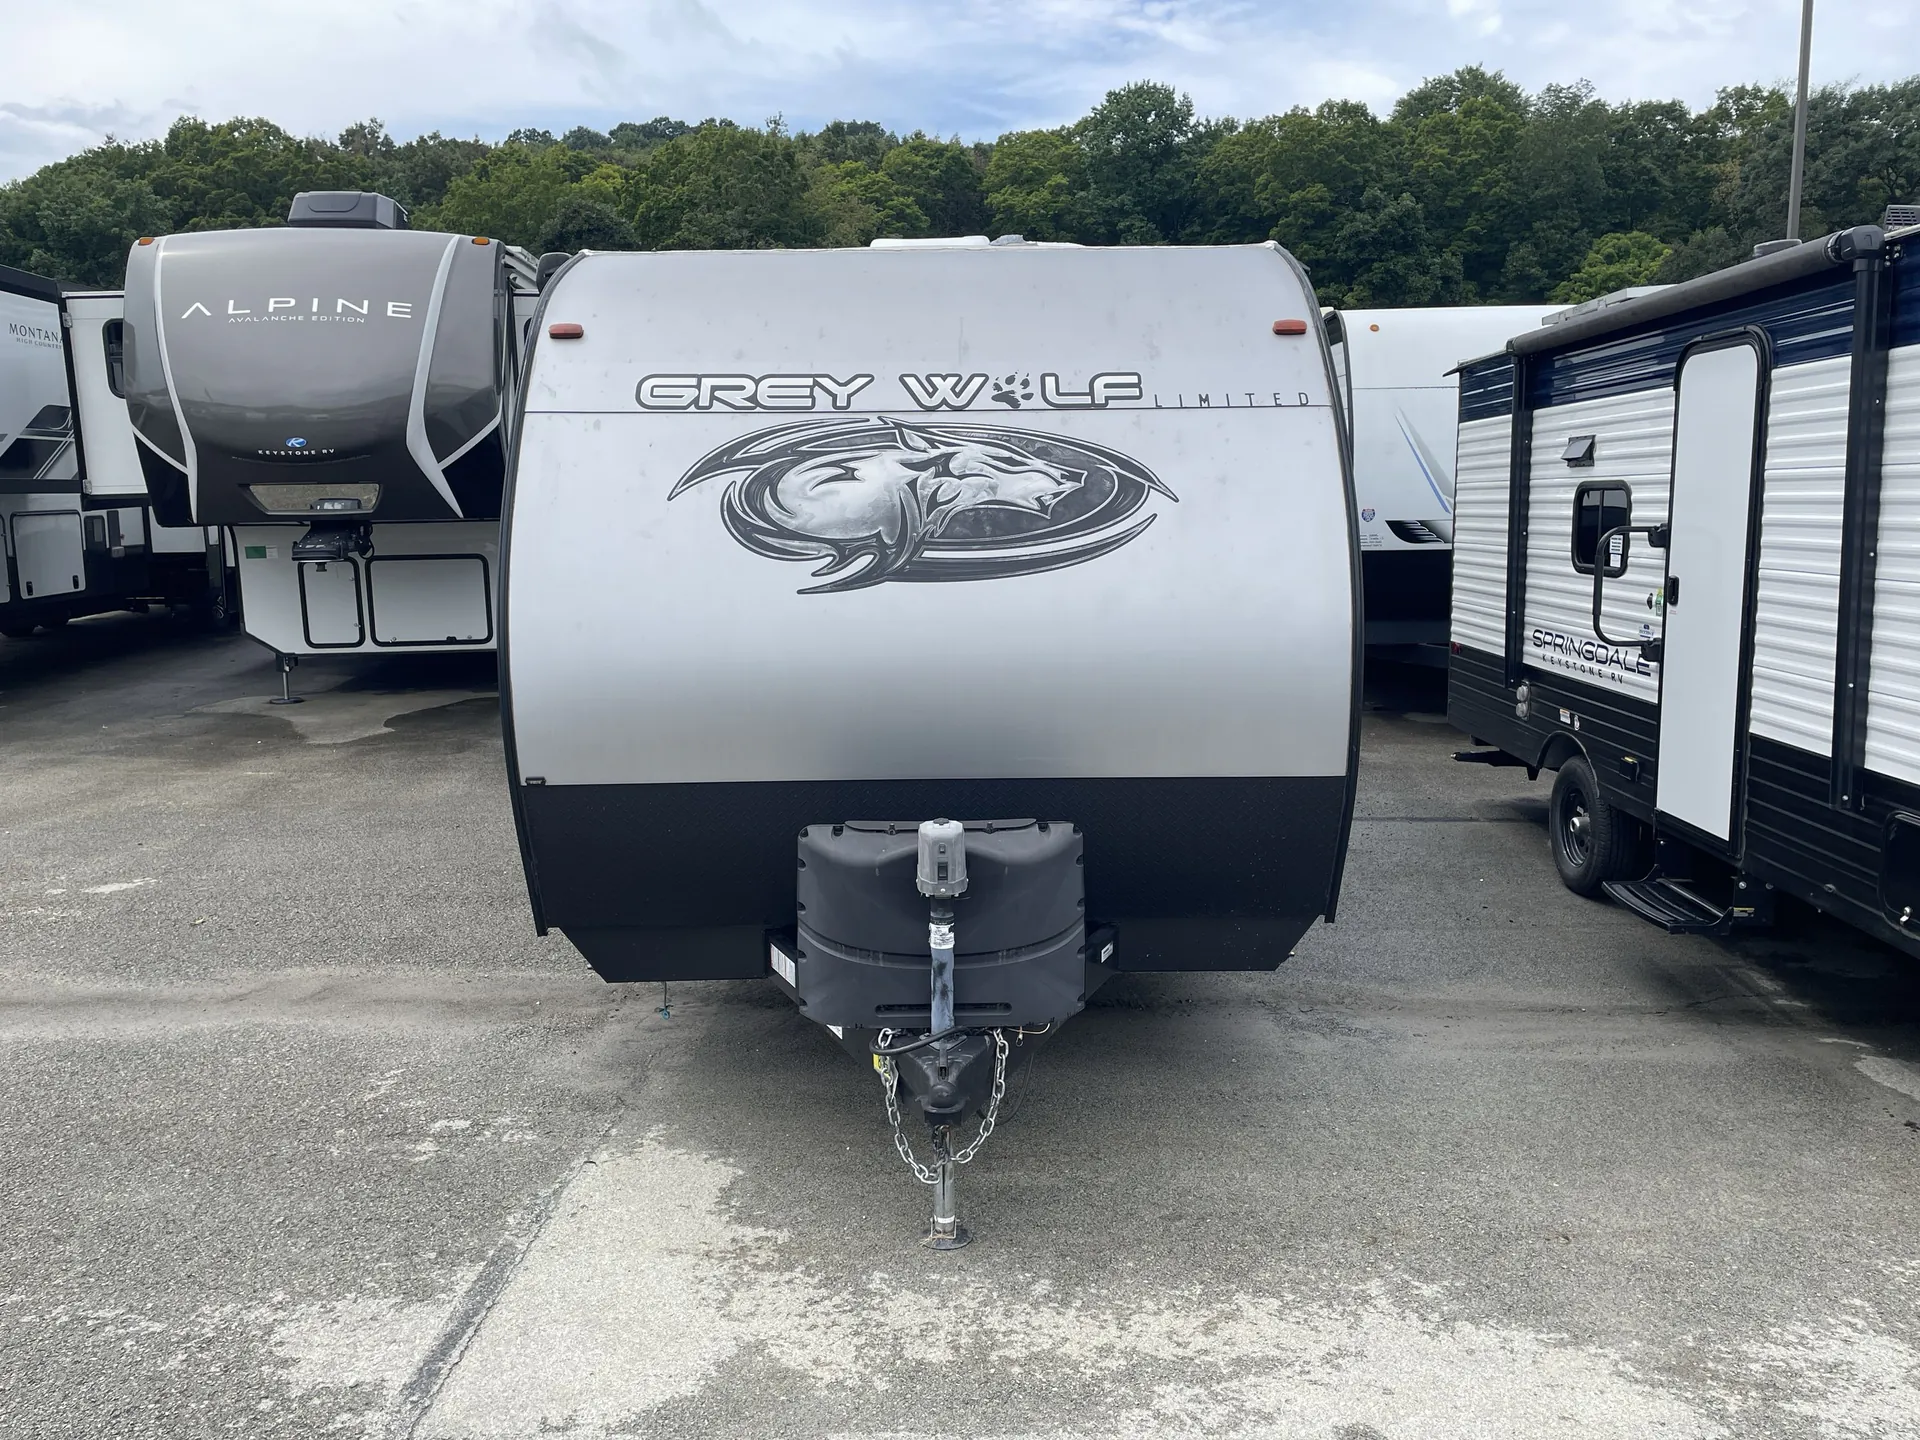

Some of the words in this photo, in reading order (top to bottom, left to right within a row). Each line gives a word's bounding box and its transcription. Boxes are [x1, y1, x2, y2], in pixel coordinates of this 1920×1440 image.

[181, 297, 412, 319] ALPINE
[228, 315, 304, 323] AVALANCHE
[312, 315, 365, 323] EDITION
[635, 373, 875, 410] GREY
[1154, 392, 1310, 408] LIMITED
[1532, 629, 1651, 677] SPRINGDALE
[1542, 654, 1603, 679] KEYSTONE
[1610, 672, 1624, 684] RV
